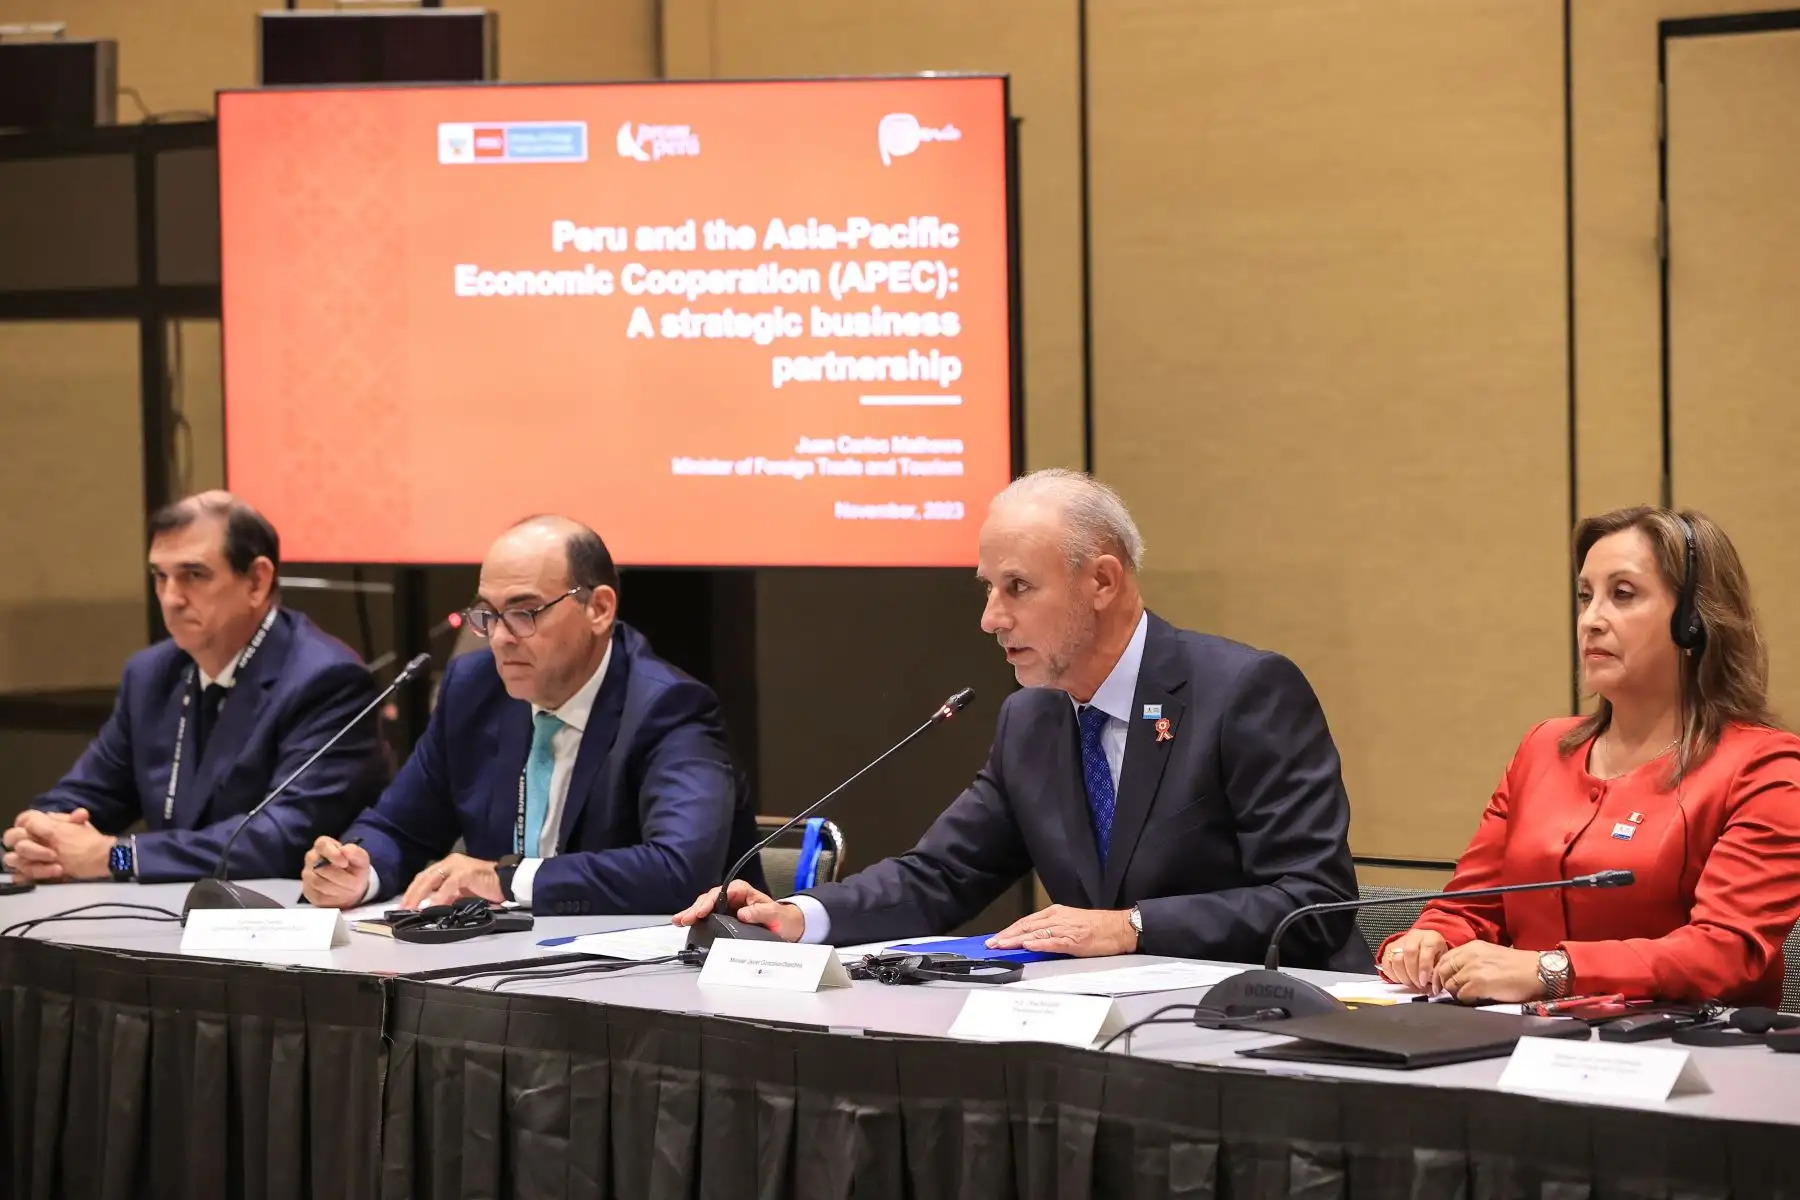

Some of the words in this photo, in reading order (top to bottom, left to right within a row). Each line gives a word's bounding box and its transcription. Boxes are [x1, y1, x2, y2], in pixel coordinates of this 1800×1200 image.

[552, 219, 628, 252] Peru
[634, 219, 697, 252] and
[702, 218, 757, 251] the
[763, 216, 960, 250] Asia-Pacific
[454, 264, 615, 297] Economic
[620, 262, 822, 302] Cooperation
[828, 260, 959, 300] (APEC):
[627, 307, 655, 339] A
[659, 305, 804, 345] strategic
[810, 305, 961, 338] business
[771, 349, 963, 389] partnership
[795, 435, 836, 455] Juan
[836, 435, 890, 455] Carlos
[671, 456, 734, 476] Minister
[734, 456, 754, 476] of
[753, 456, 815, 480] Foreign
[815, 457, 864, 476] Trade
[864, 458, 897, 476] and
[898, 457, 964, 476] Tourism
[834, 500, 922, 521] November,
[922, 500, 965, 520] 2023
[1244, 981, 1295, 1000] BOSCH
